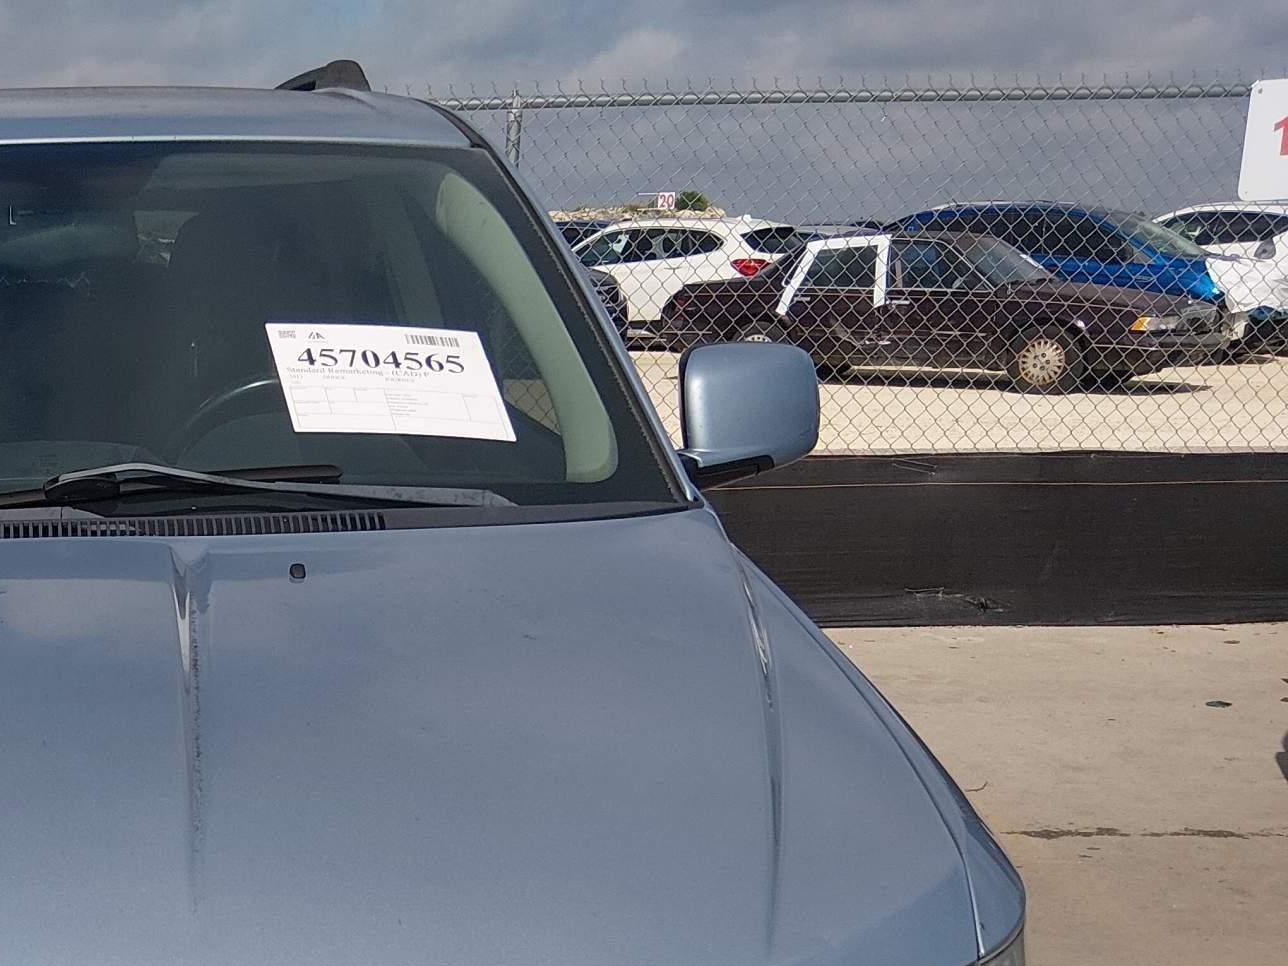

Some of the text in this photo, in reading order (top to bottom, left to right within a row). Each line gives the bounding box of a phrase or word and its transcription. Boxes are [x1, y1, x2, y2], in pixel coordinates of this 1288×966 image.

[659, 194, 674, 208] 20
[297, 347, 464, 374] 45704565
[328, 367, 383, 377] Remarketing
